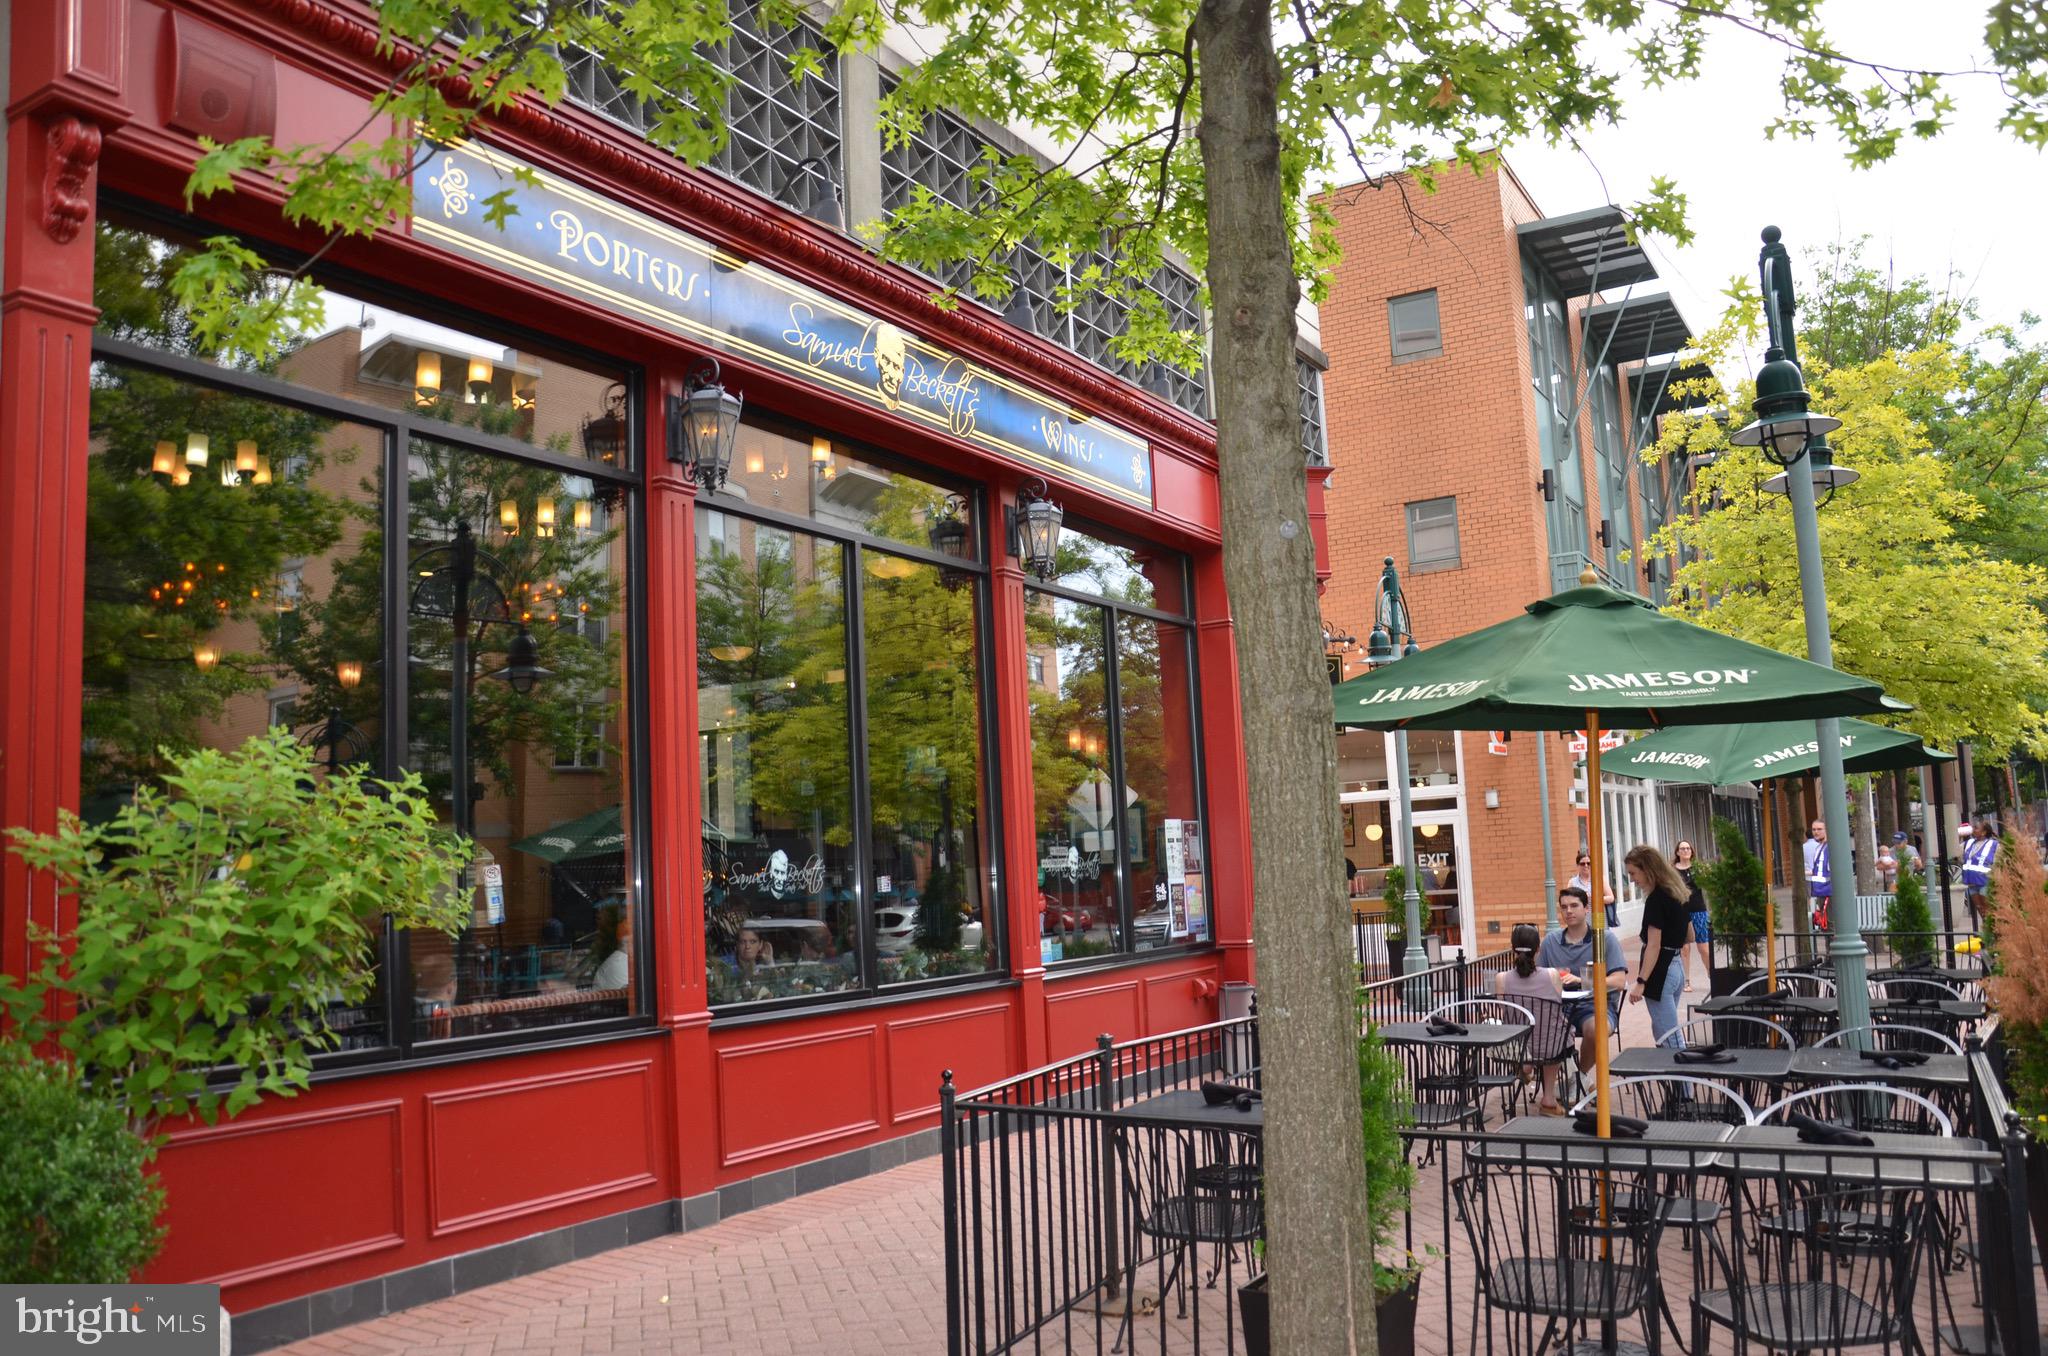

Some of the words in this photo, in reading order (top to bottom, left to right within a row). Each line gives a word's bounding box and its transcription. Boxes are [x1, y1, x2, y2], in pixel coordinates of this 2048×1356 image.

[550, 210, 699, 302] PORTERS
[782, 302, 883, 371] Samuel
[904, 355, 979, 437] Beckett's
[1040, 416, 1095, 463] WINES
[1359, 680, 1489, 705] JAMESON
[1567, 669, 1751, 692] JAMESON
[1573, 743, 1585, 751] ICE
[1753, 735, 1852, 768] JAMESN
[1631, 752, 1710, 769] JAMESON
[1418, 853, 1449, 868] EXIT
